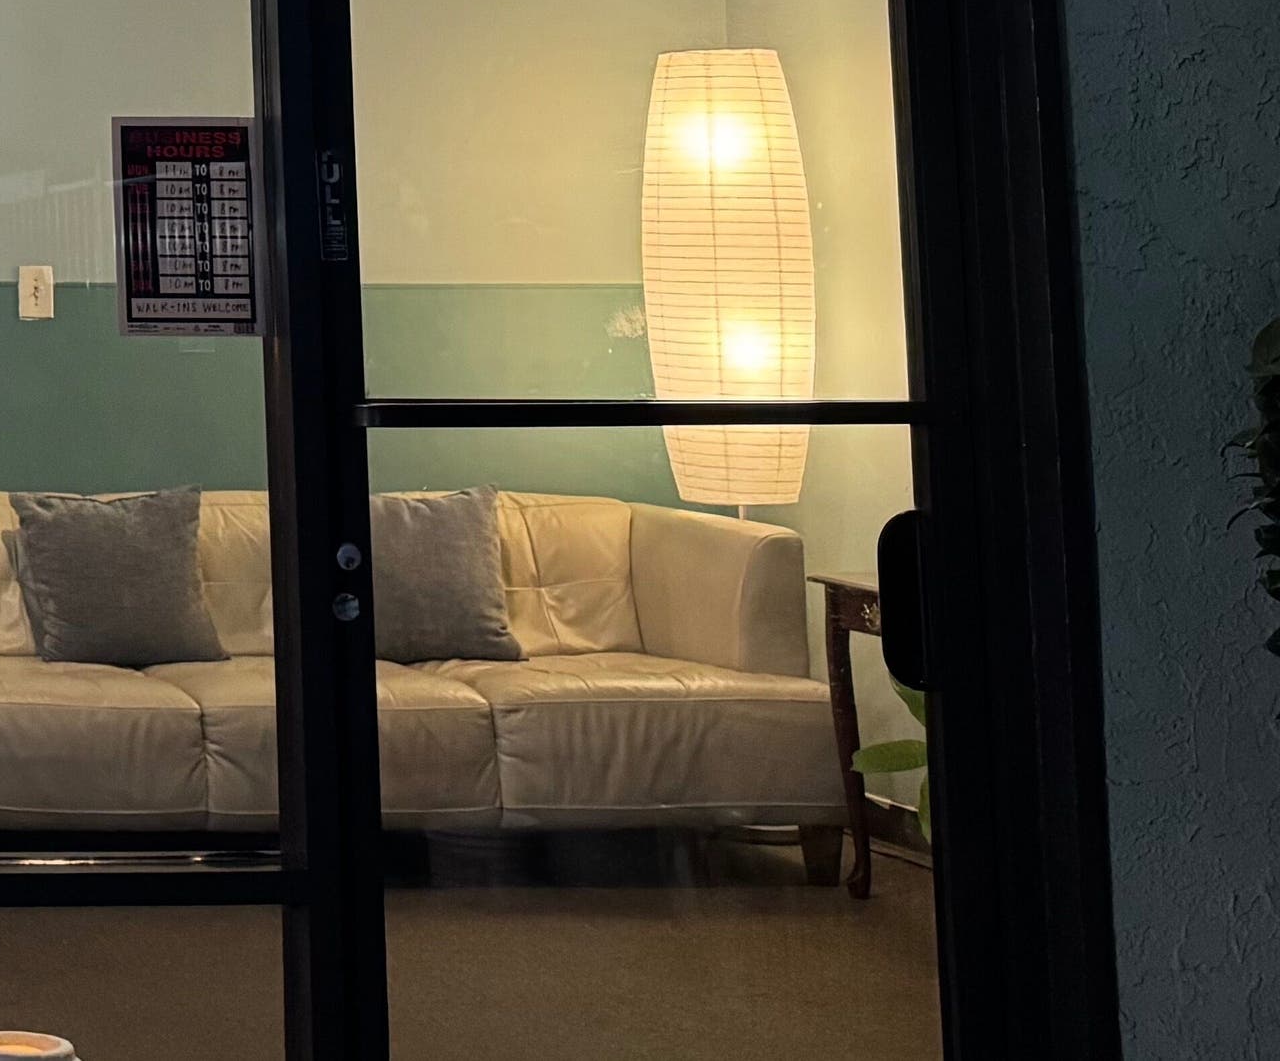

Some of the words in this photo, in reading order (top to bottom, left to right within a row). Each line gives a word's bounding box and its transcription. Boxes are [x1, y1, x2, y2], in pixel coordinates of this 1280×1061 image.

[146, 145, 225, 158] HOURS
[194, 164, 207, 176] TO
[195, 184, 208, 195] TO
[196, 203, 208, 214] TO
[196, 222, 209, 233] TO
[198, 260, 210, 272] TO
[199, 280, 211, 291] TO
[136, 302, 197, 314] WALK-INS
[202, 302, 249, 314] WELCOME
